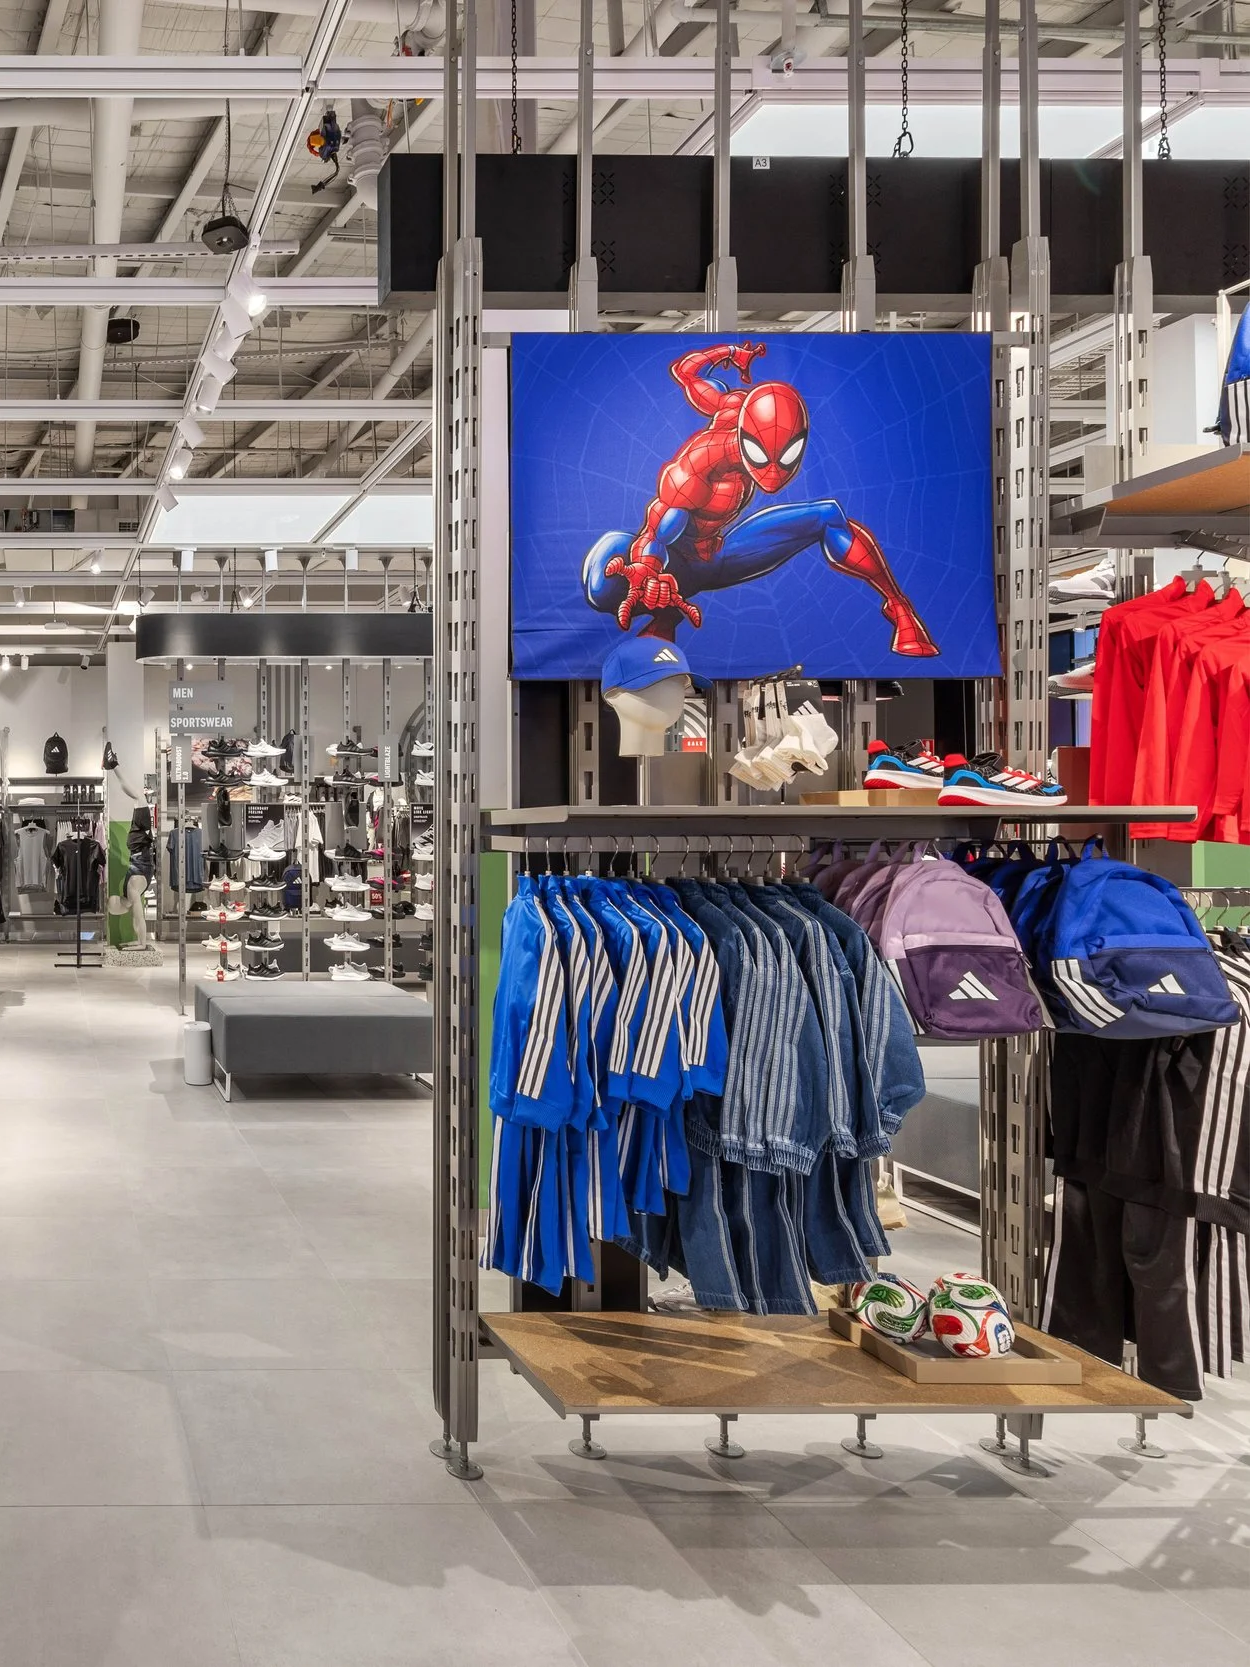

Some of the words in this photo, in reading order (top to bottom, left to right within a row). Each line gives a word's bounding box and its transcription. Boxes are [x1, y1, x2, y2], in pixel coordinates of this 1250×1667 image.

[755, 158, 767, 168] A3
[172, 687, 194, 699] MEN
[171, 717, 233, 728] SPORTSWEAR
